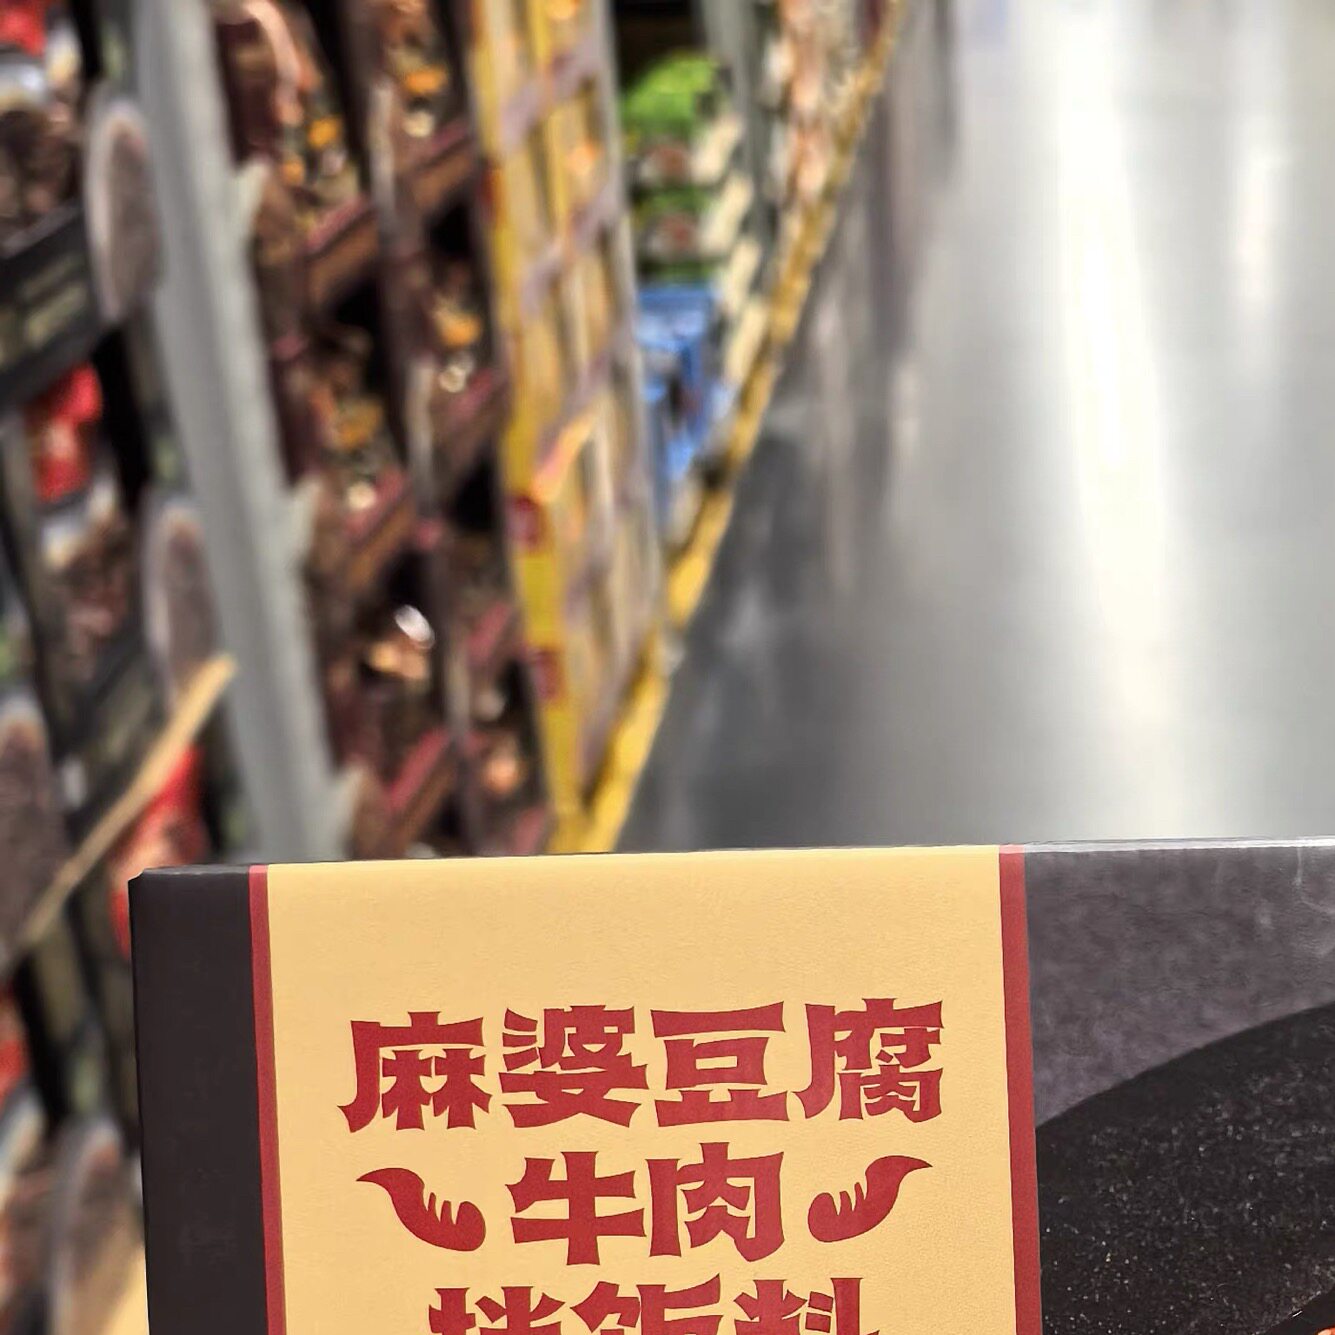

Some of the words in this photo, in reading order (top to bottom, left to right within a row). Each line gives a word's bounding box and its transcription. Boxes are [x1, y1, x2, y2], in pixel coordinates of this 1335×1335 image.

[338, 998, 943, 1132] 麻婆豆腐
[507, 1142, 785, 1265] 牛肉
